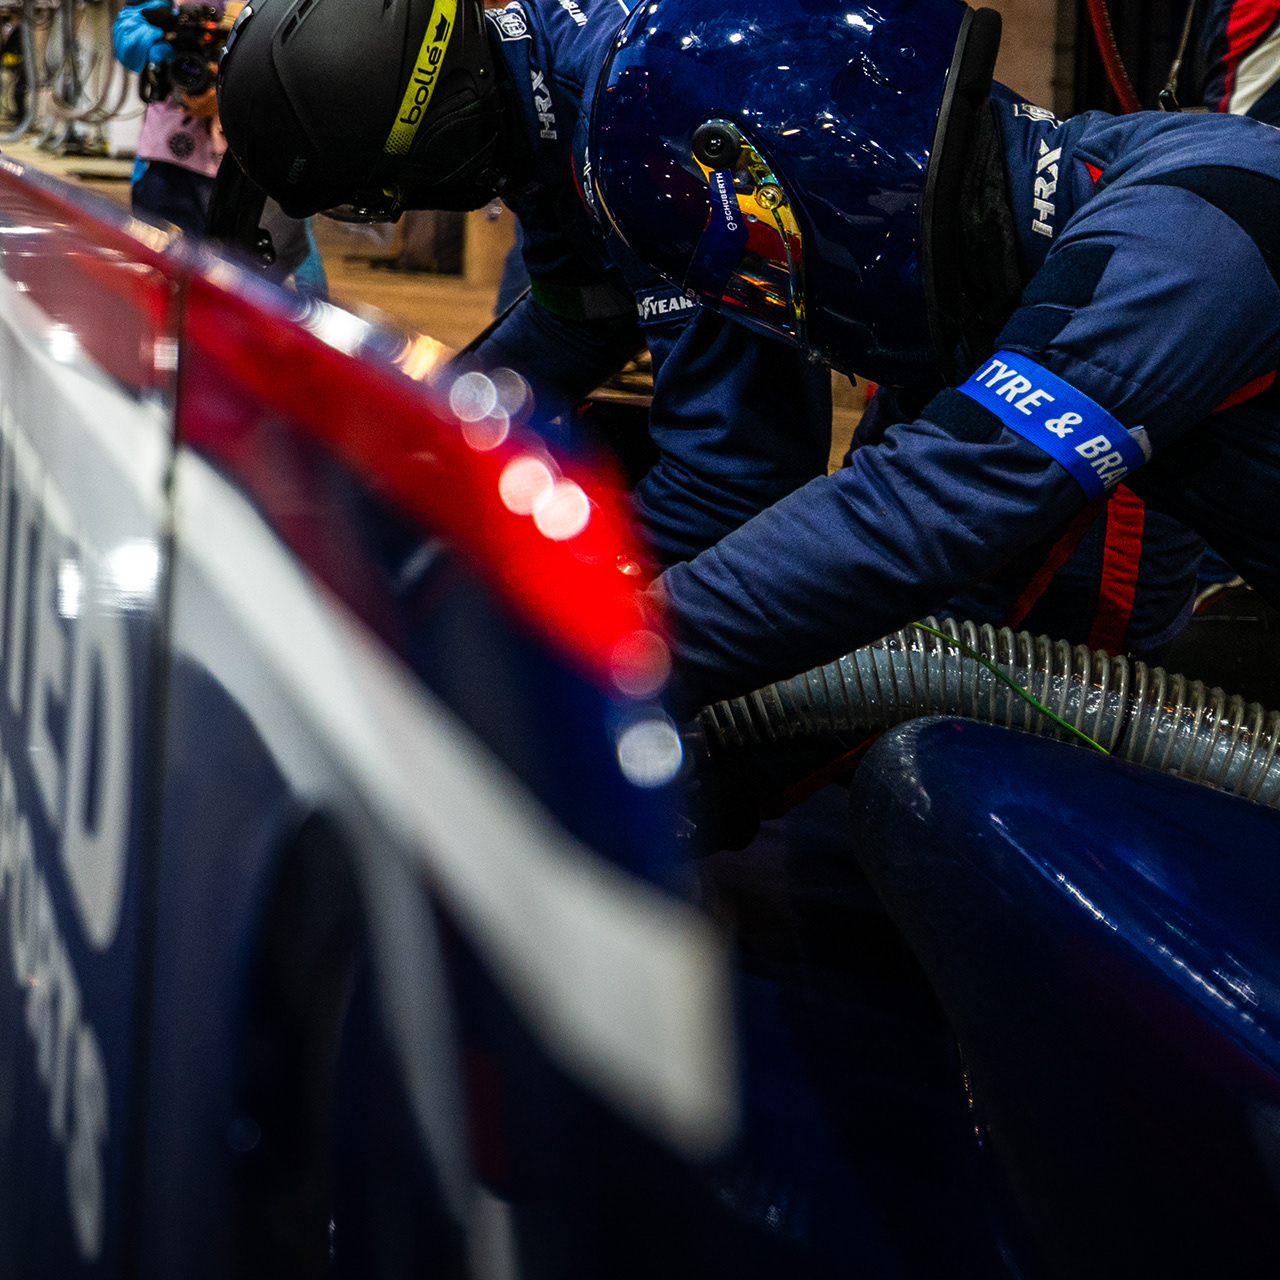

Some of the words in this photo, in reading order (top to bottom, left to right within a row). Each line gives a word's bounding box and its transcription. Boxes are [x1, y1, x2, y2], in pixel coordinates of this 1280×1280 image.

[400, 45, 443, 125] bollé
[714, 172, 733, 222] SCHUBERTH
[1032, 138, 1062, 238] HRX
[976, 358, 1055, 416] TYRE
[1044, 411, 1083, 439] &
[1075, 434, 1130, 489] BRA
